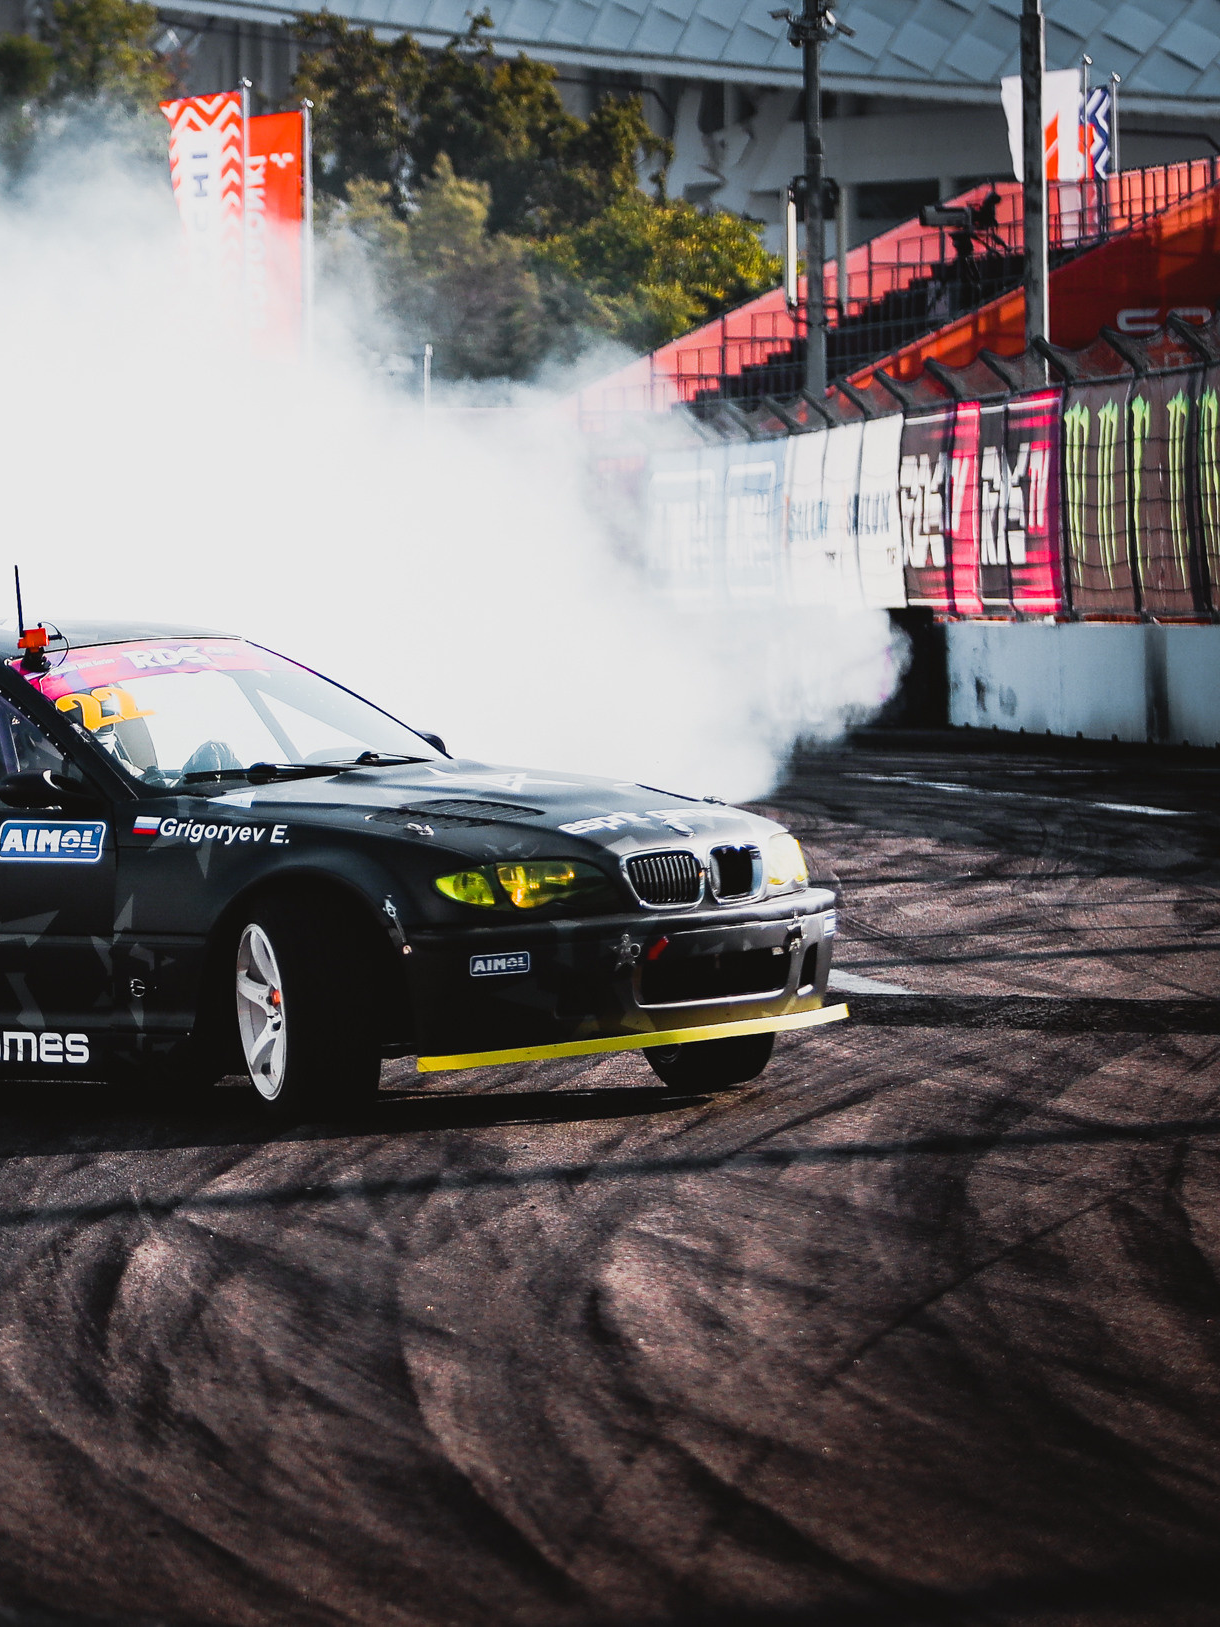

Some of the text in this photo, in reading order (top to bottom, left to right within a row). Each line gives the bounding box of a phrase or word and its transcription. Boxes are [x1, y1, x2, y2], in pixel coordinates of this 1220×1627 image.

[121, 646, 212, 669] RDS
[56, 687, 157, 731] 22
[0, 828, 97, 853] AIMOL
[159, 817, 291, 845] Grigoryev E.
[472, 956, 527, 972] AIMOL
